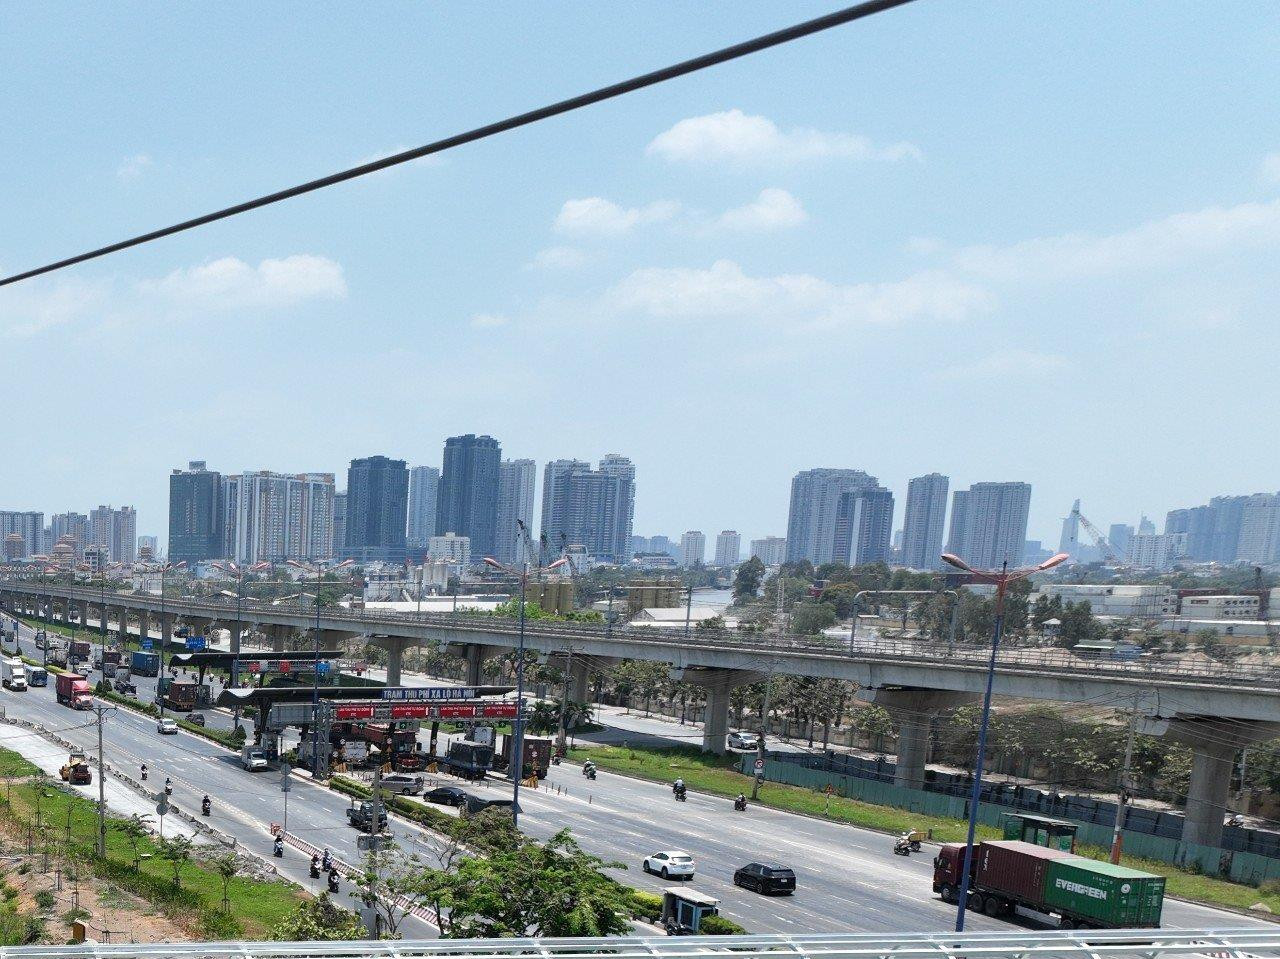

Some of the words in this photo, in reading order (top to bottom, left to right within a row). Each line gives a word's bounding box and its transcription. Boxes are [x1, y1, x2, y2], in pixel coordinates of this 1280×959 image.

[404, 690, 417, 699] THU
[431, 690, 441, 699] XA
[1055, 878, 1107, 900] EVERGREEN
